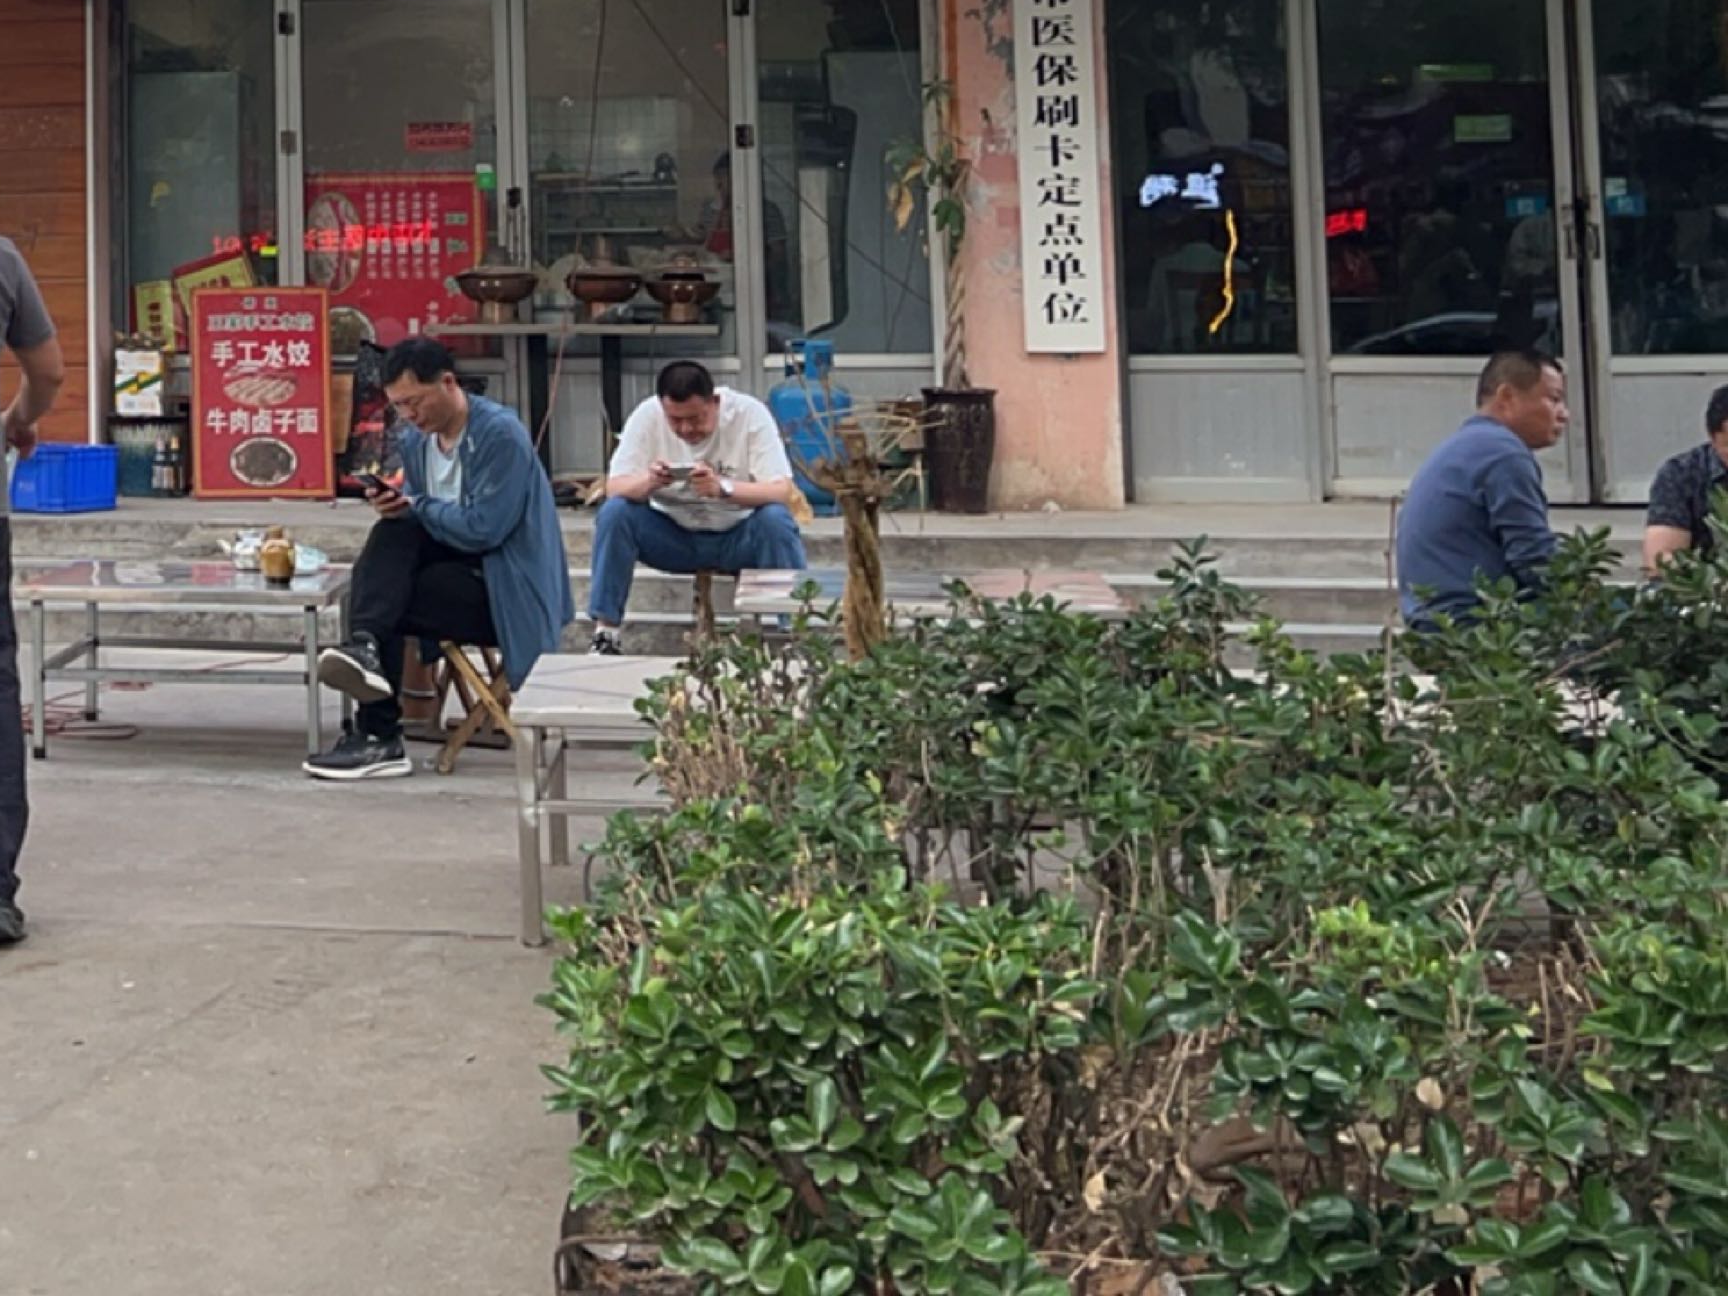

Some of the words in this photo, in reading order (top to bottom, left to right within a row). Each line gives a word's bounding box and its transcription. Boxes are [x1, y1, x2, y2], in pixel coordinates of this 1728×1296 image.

[211, 339, 311, 368] 手工水饺
[206, 407, 319, 435] 牛肉卤子面
